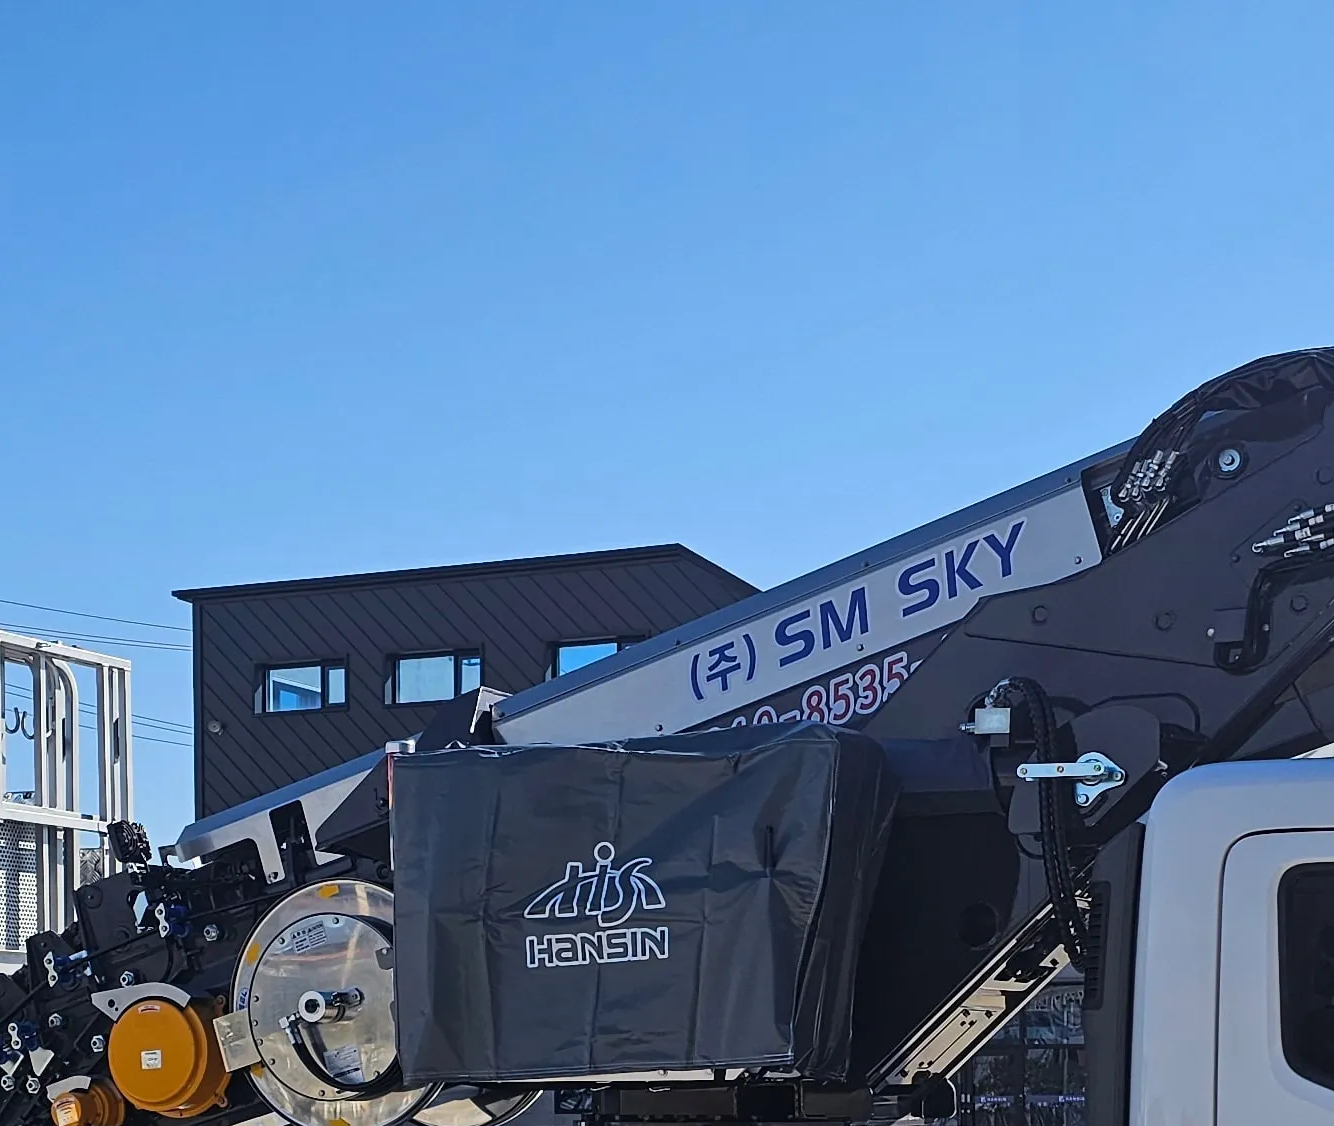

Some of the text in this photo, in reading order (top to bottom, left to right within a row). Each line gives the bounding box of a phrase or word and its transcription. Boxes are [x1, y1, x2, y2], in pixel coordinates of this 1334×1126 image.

[690, 520, 1026, 700] (주) SM SKY
